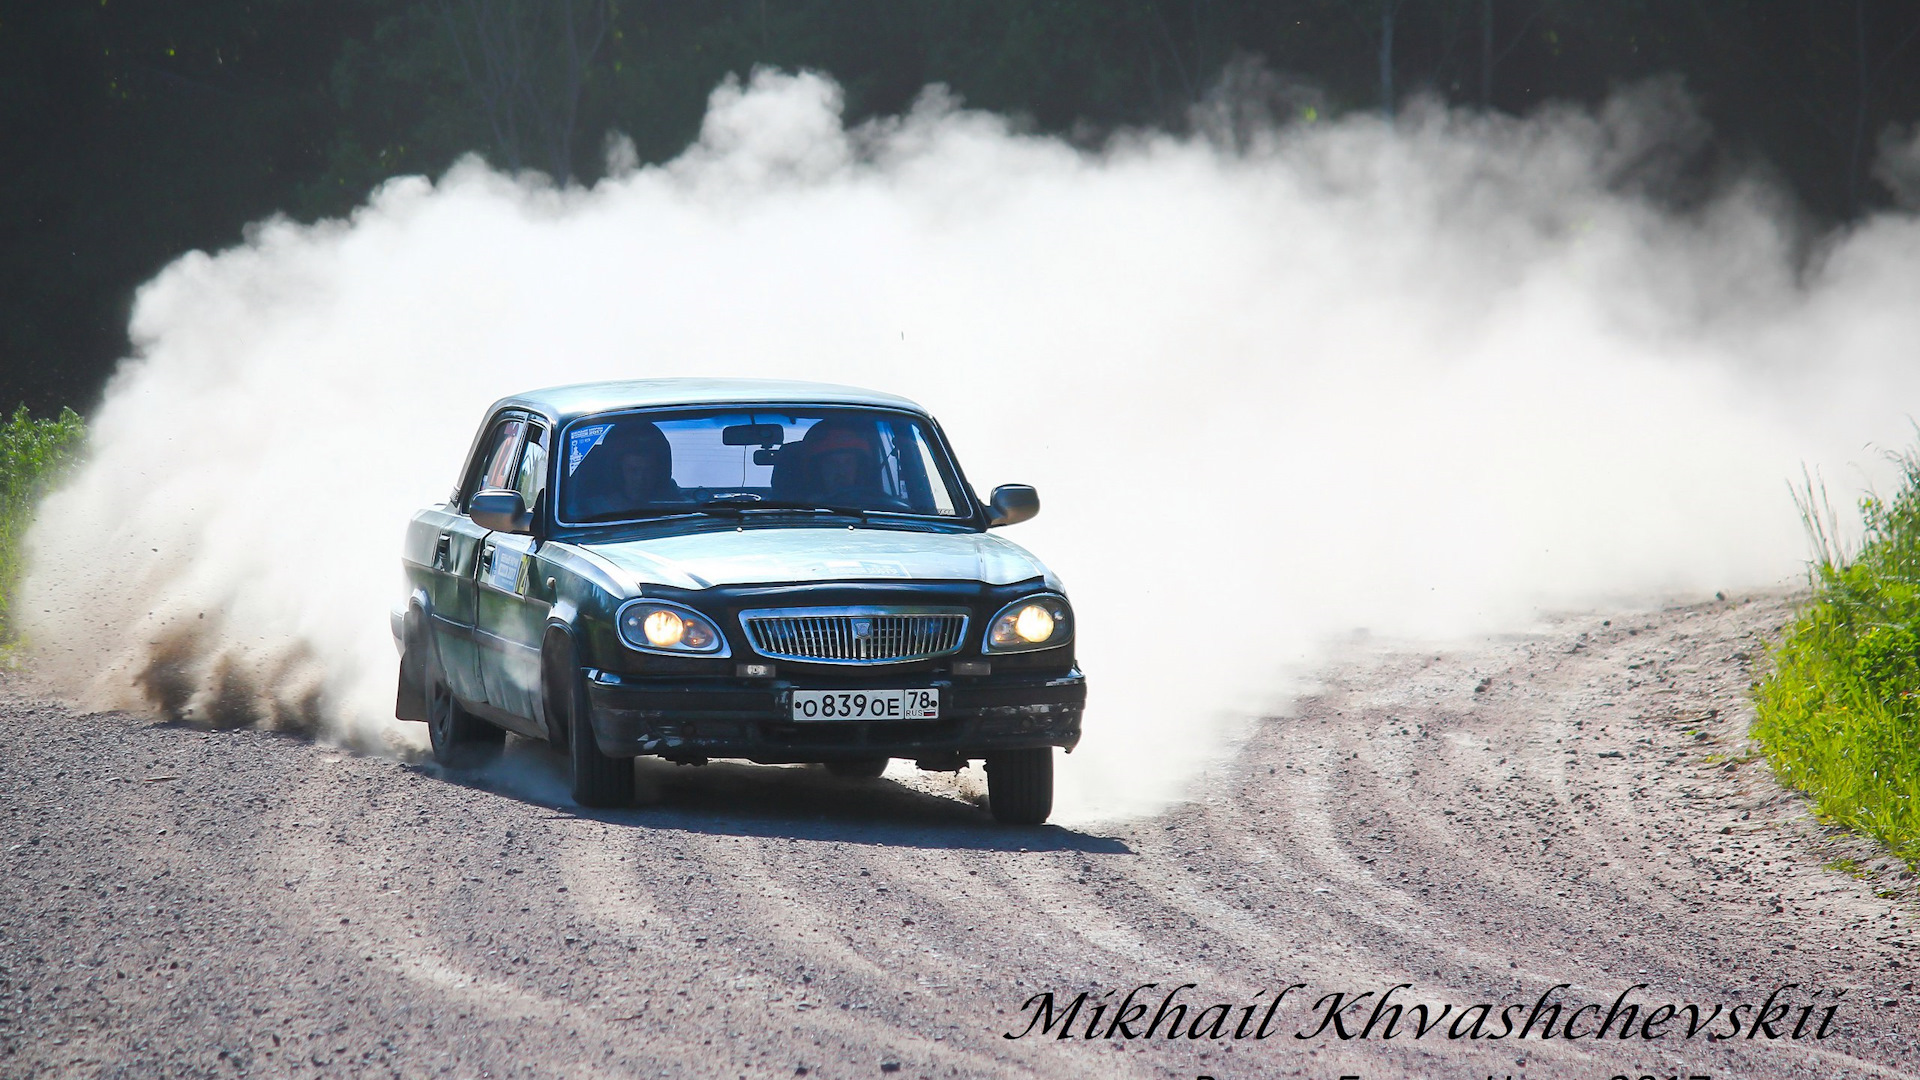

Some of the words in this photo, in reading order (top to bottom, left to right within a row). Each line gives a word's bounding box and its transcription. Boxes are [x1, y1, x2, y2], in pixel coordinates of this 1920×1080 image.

[803, 694, 900, 717] O839OE
[907, 691, 930, 709] 78
[905, 709, 923, 717] RUS
